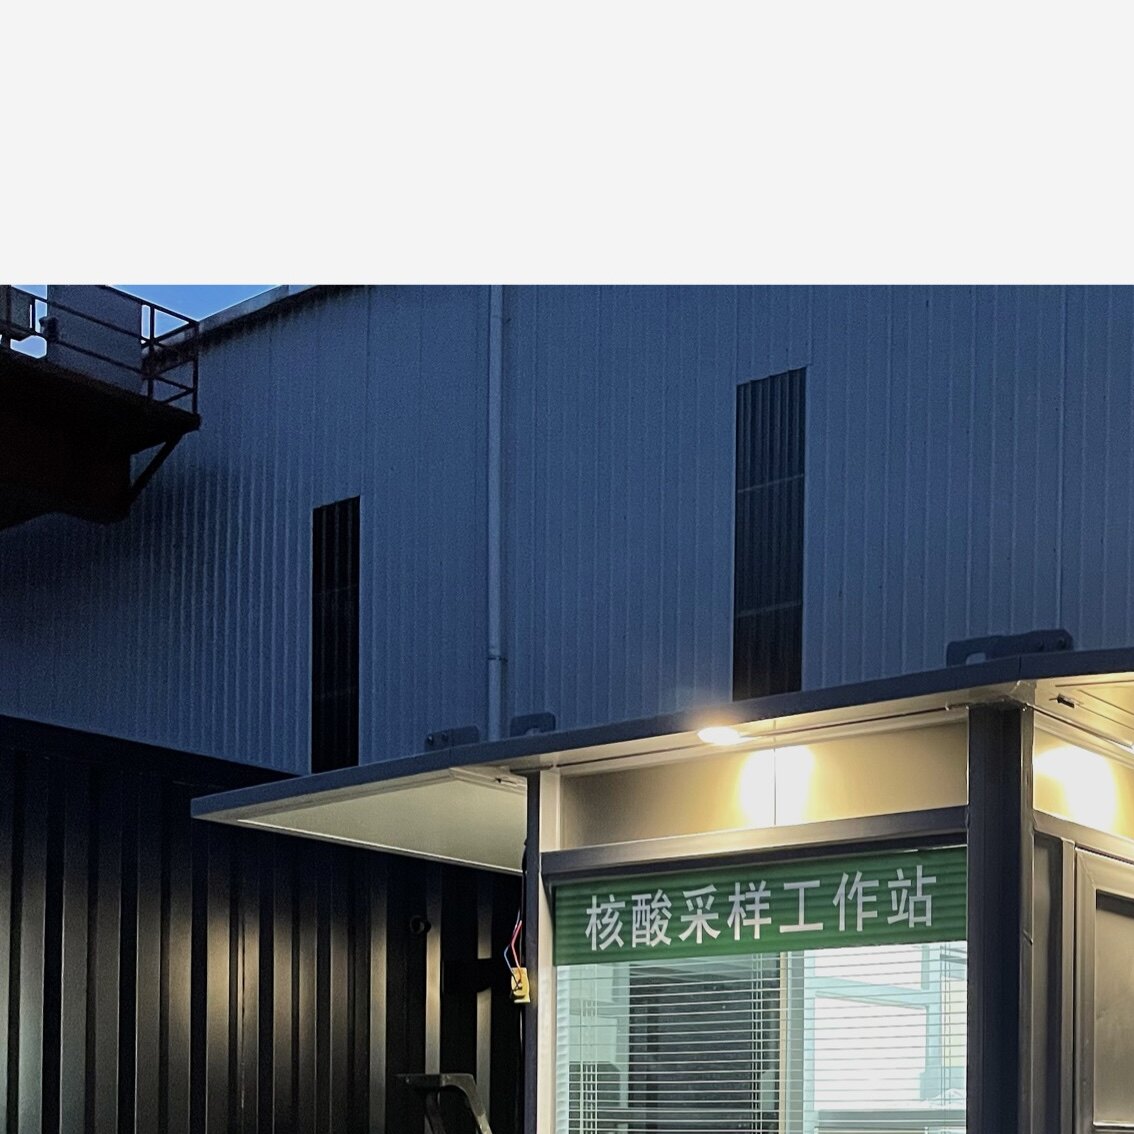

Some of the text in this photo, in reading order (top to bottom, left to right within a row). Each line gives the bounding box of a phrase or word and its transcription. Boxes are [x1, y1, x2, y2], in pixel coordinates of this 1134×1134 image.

[585, 864, 938, 951] 核酸采样工作站
